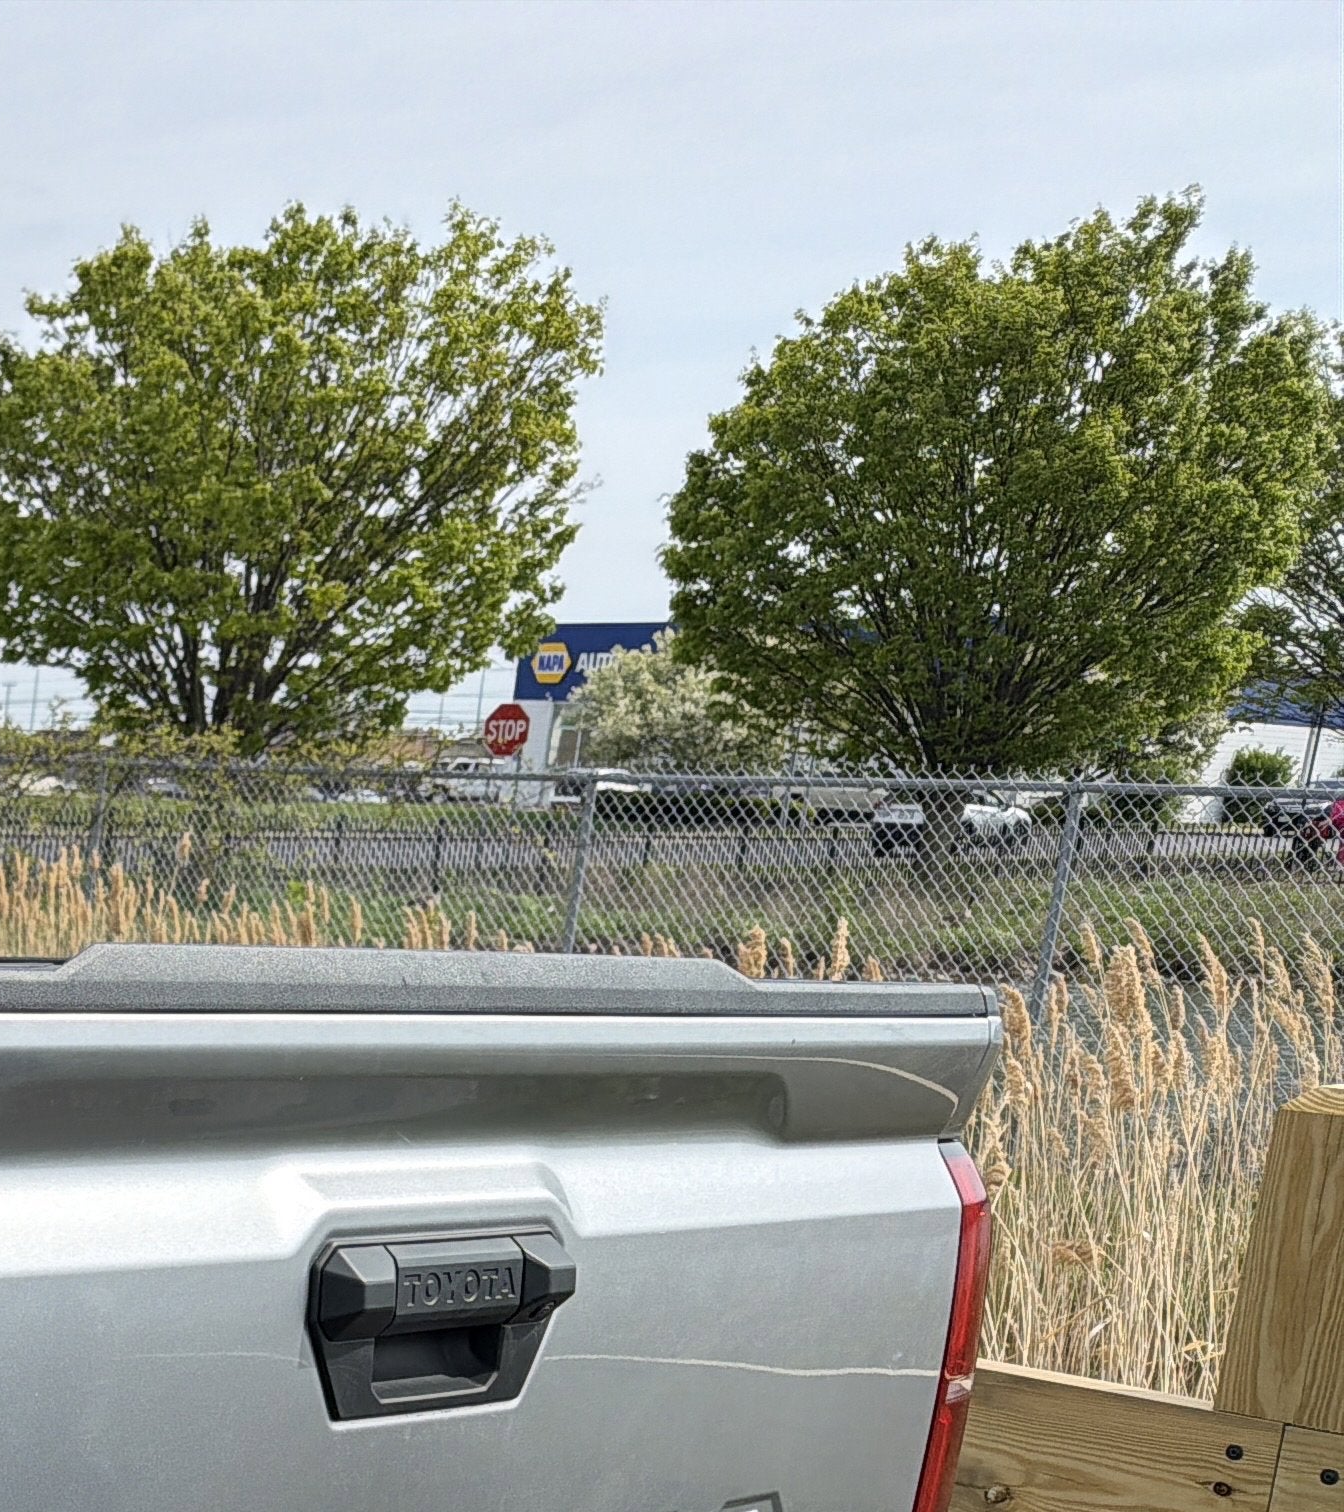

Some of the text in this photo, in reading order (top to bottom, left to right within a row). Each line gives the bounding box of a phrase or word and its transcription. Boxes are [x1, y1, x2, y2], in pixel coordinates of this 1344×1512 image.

[538, 654, 565, 673] NAPA
[487, 719, 527, 744] STOP
[403, 1266, 517, 1308] TOYOTA
